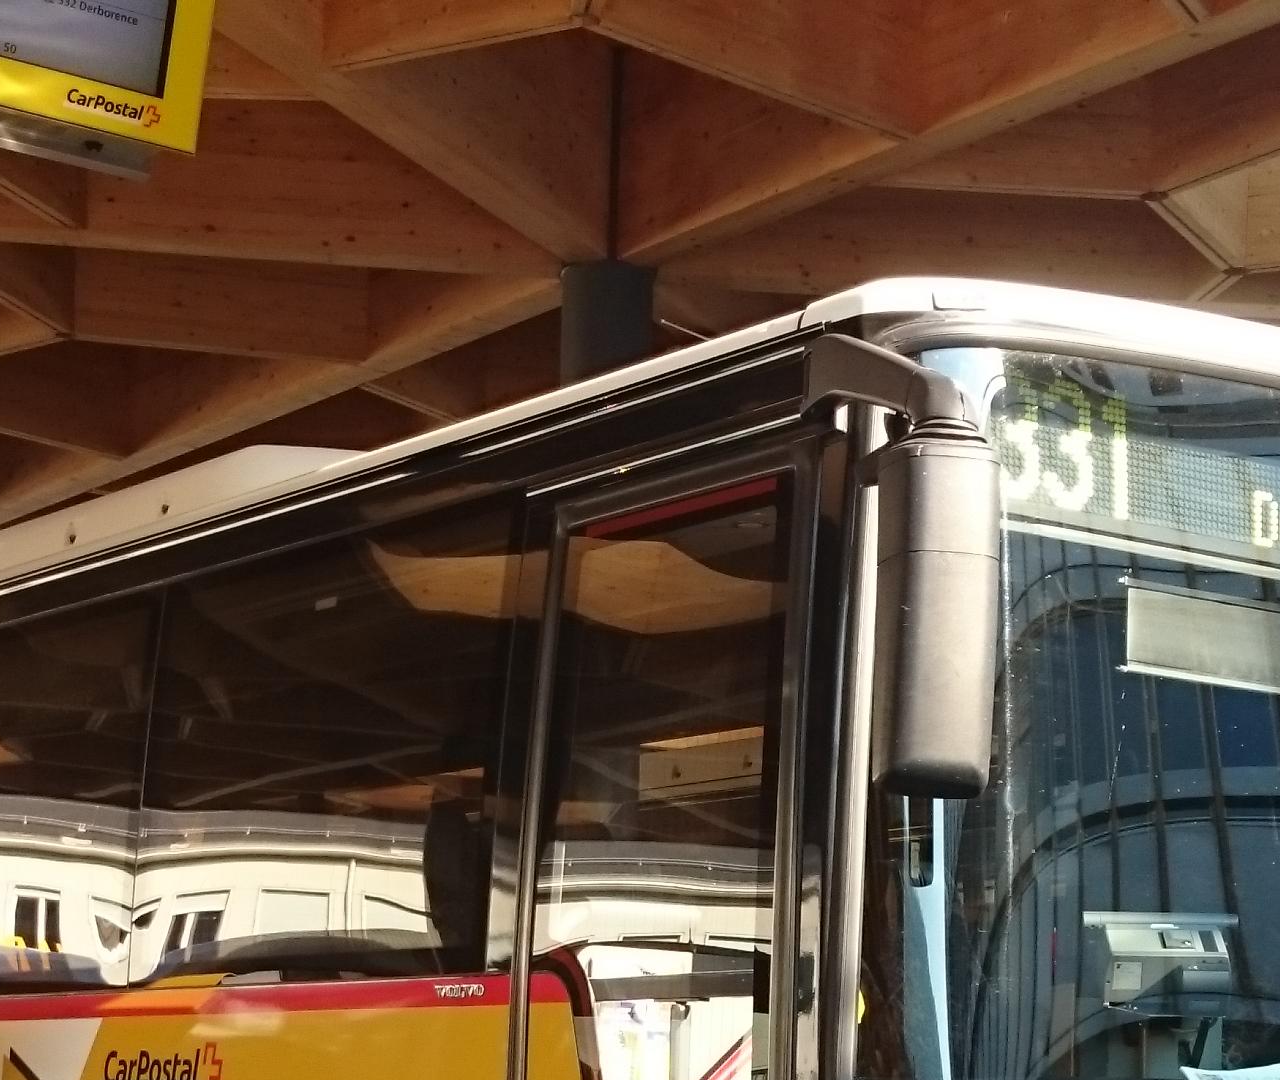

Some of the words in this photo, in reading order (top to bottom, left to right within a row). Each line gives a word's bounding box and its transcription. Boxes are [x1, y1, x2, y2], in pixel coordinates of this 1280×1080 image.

[80, 1, 138, 26] Derborence
[67, 88, 144, 120] CarPostal
[1000, 370, 1129, 521] 331
[434, 984, 485, 998] VOLVO
